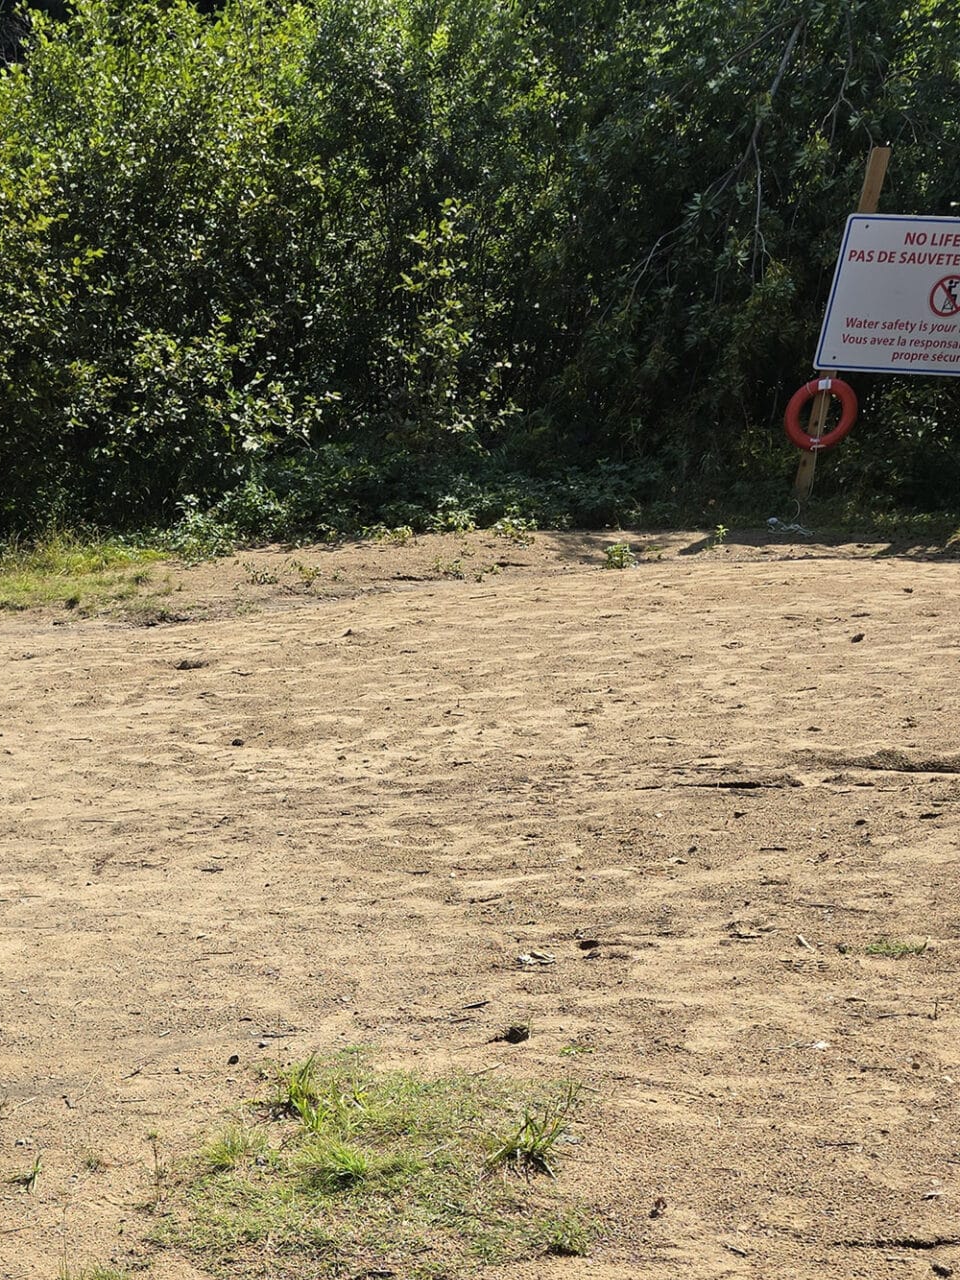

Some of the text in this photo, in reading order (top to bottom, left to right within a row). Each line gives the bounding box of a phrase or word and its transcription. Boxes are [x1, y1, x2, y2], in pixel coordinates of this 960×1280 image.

[904, 232, 960, 247] NO LIFE
[848, 250, 960, 266] PAS DE SAUVETE
[845, 317, 878, 329] Water
[881, 319, 916, 333] safety
[920, 320, 928, 331] is
[929, 323, 956, 335] your
[842, 333, 960, 350] Vous avez la responsa
[891, 351, 929, 362] propre
